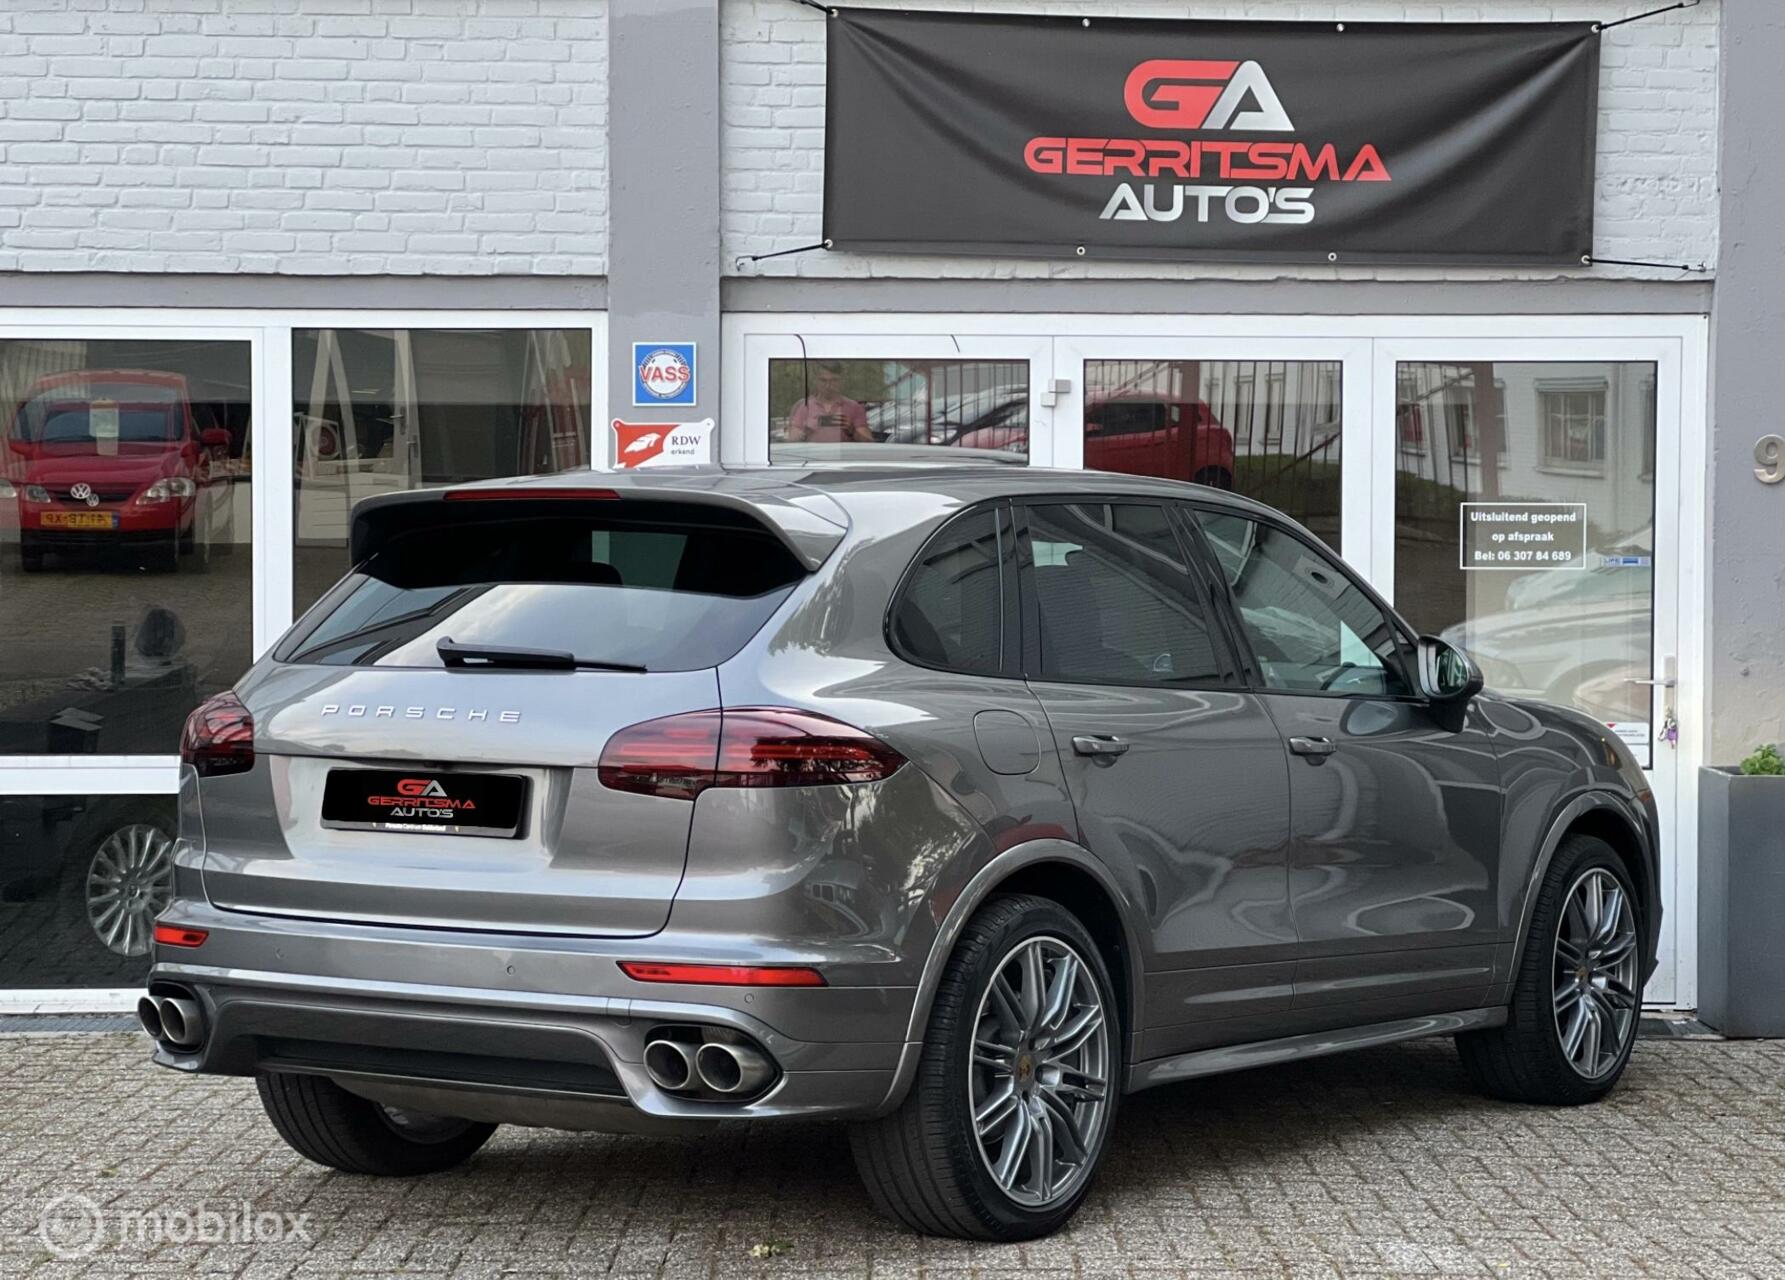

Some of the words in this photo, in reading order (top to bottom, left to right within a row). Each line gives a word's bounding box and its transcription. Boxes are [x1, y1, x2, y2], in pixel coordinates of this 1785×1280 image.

[1124, 59, 1294, 132] GA
[1024, 136, 1392, 182] GERRITSMA
[1099, 183, 1316, 225] AUTO'S
[640, 366, 690, 382] VASS
[671, 435, 701, 446] RDW
[1753, 433, 1785, 485] 9
[1470, 512, 1528, 522] Uitsluitend
[1531, 512, 1576, 524] geopend
[1492, 533, 1506, 543] op
[1508, 531, 1554, 543] afspraak
[1474, 551, 1495, 561] Bel:
[1497, 551, 1511, 561] 06
[1514, 551, 1532, 561] 307
[1535, 551, 1549, 561] 84
[1551, 551, 1571, 561] 689
[321, 703, 521, 723] PORSCHE
